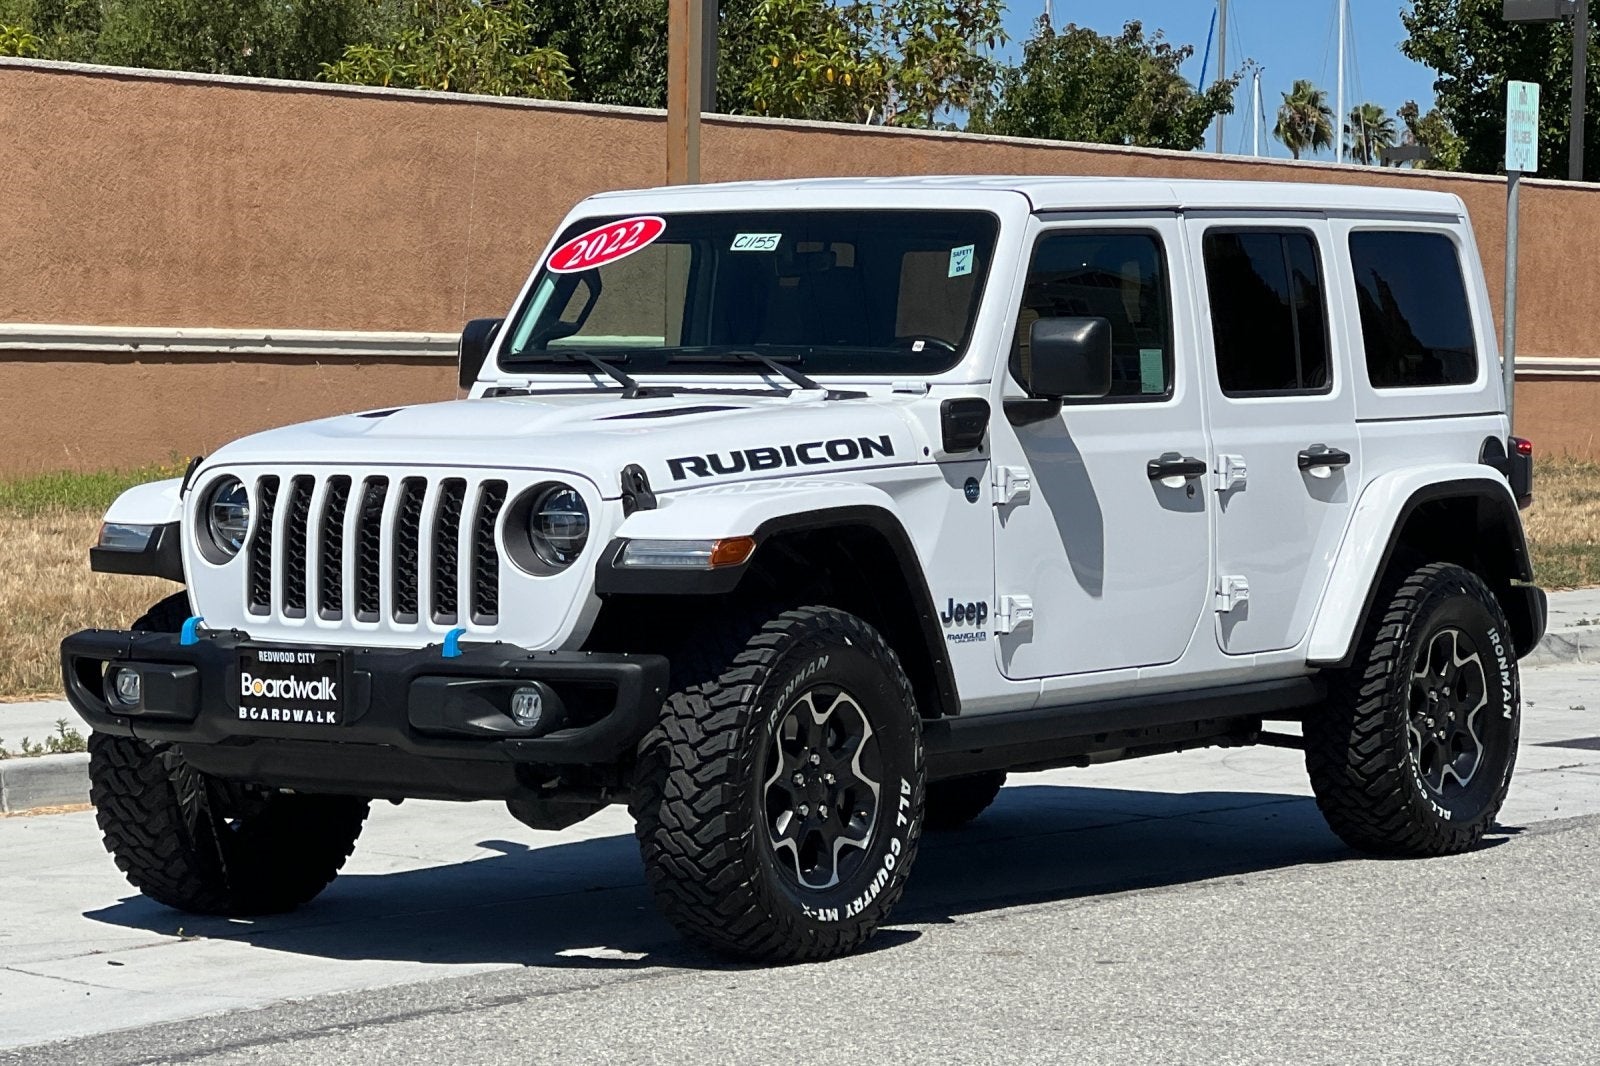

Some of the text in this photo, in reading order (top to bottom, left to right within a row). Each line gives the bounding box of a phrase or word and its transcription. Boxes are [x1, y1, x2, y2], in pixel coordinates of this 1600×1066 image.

[563, 221, 646, 269] 2022
[734, 235, 778, 249] C1155
[953, 248, 973, 258] SAFETY
[955, 265, 966, 273] OK
[665, 434, 896, 482] RUBICON
[940, 597, 988, 626] Jeep
[258, 650, 316, 664] REDWOOD CITY
[241, 672, 337, 701] Boardwalk
[1486, 626, 1513, 720] IRONMAN
[767, 654, 829, 737] IRONMAN
[239, 706, 336, 724] BOARDWALK
[896, 777, 912, 828] ALL
[1430, 799, 1452, 820] ALL
[846, 837, 902, 919] COUNTRY
